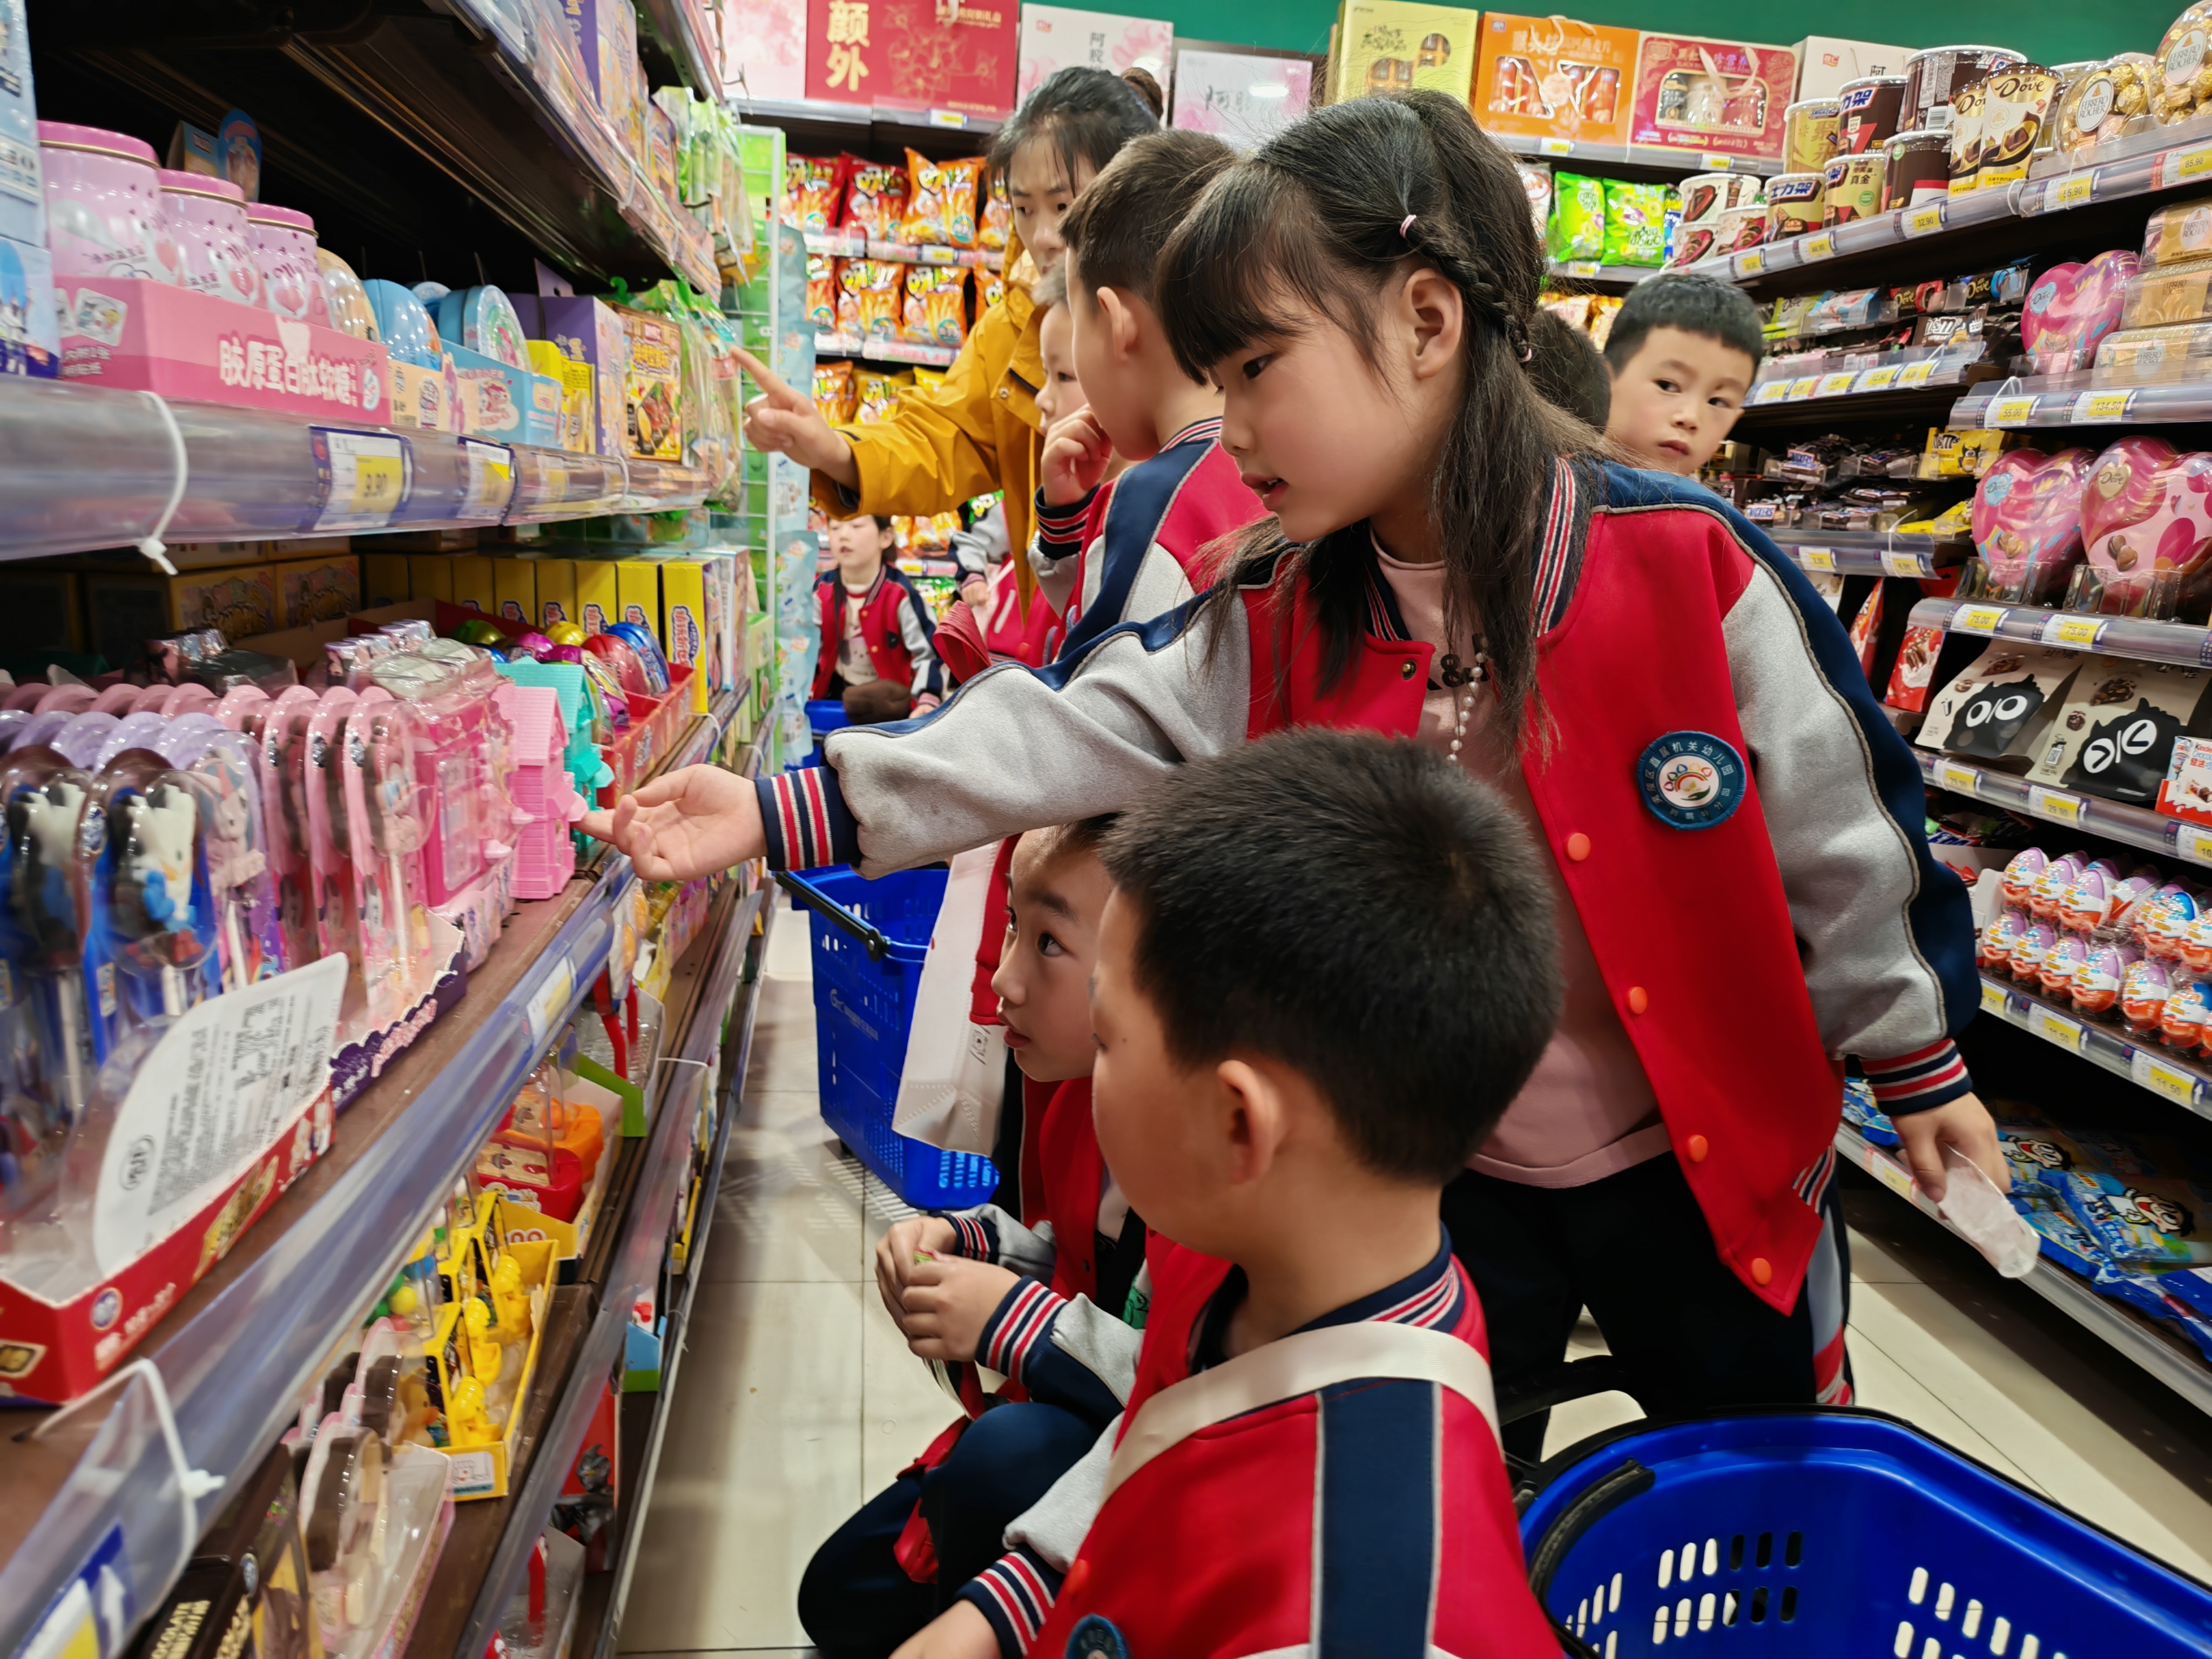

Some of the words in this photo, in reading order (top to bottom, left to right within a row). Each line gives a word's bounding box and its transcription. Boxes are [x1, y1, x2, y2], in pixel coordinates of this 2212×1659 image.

[2170, 43, 2201, 63] FERRERO
[2167, 54, 2198, 71] ROCHER
[1995, 77, 2046, 98] Dove
[2081, 95, 2109, 110] FERRERO
[2079, 105, 2106, 119] ROCHER
[2185, 157, 2204, 168] 85.90
[1770, 181, 1813, 199] 士力架
[2063, 185, 2082, 199] 55.90
[1917, 216, 1934, 227] 32.90
[2183, 218, 2209, 231] FERRERO
[2182, 226, 2207, 238] ROCHER
[1967, 280, 1990, 299] Dove
[1893, 291, 1915, 306] Dove
[2031, 292, 2051, 305] Dove
[219, 336, 351, 405] 胶原蛋白肽软糖
[2002, 408, 2022, 417] 55.00
[2095, 401, 2121, 412] 134.50
[2099, 471, 2125, 485] Dove
[1971, 615, 1991, 625] 75.00
[2066, 625, 2088, 637] 75.00
